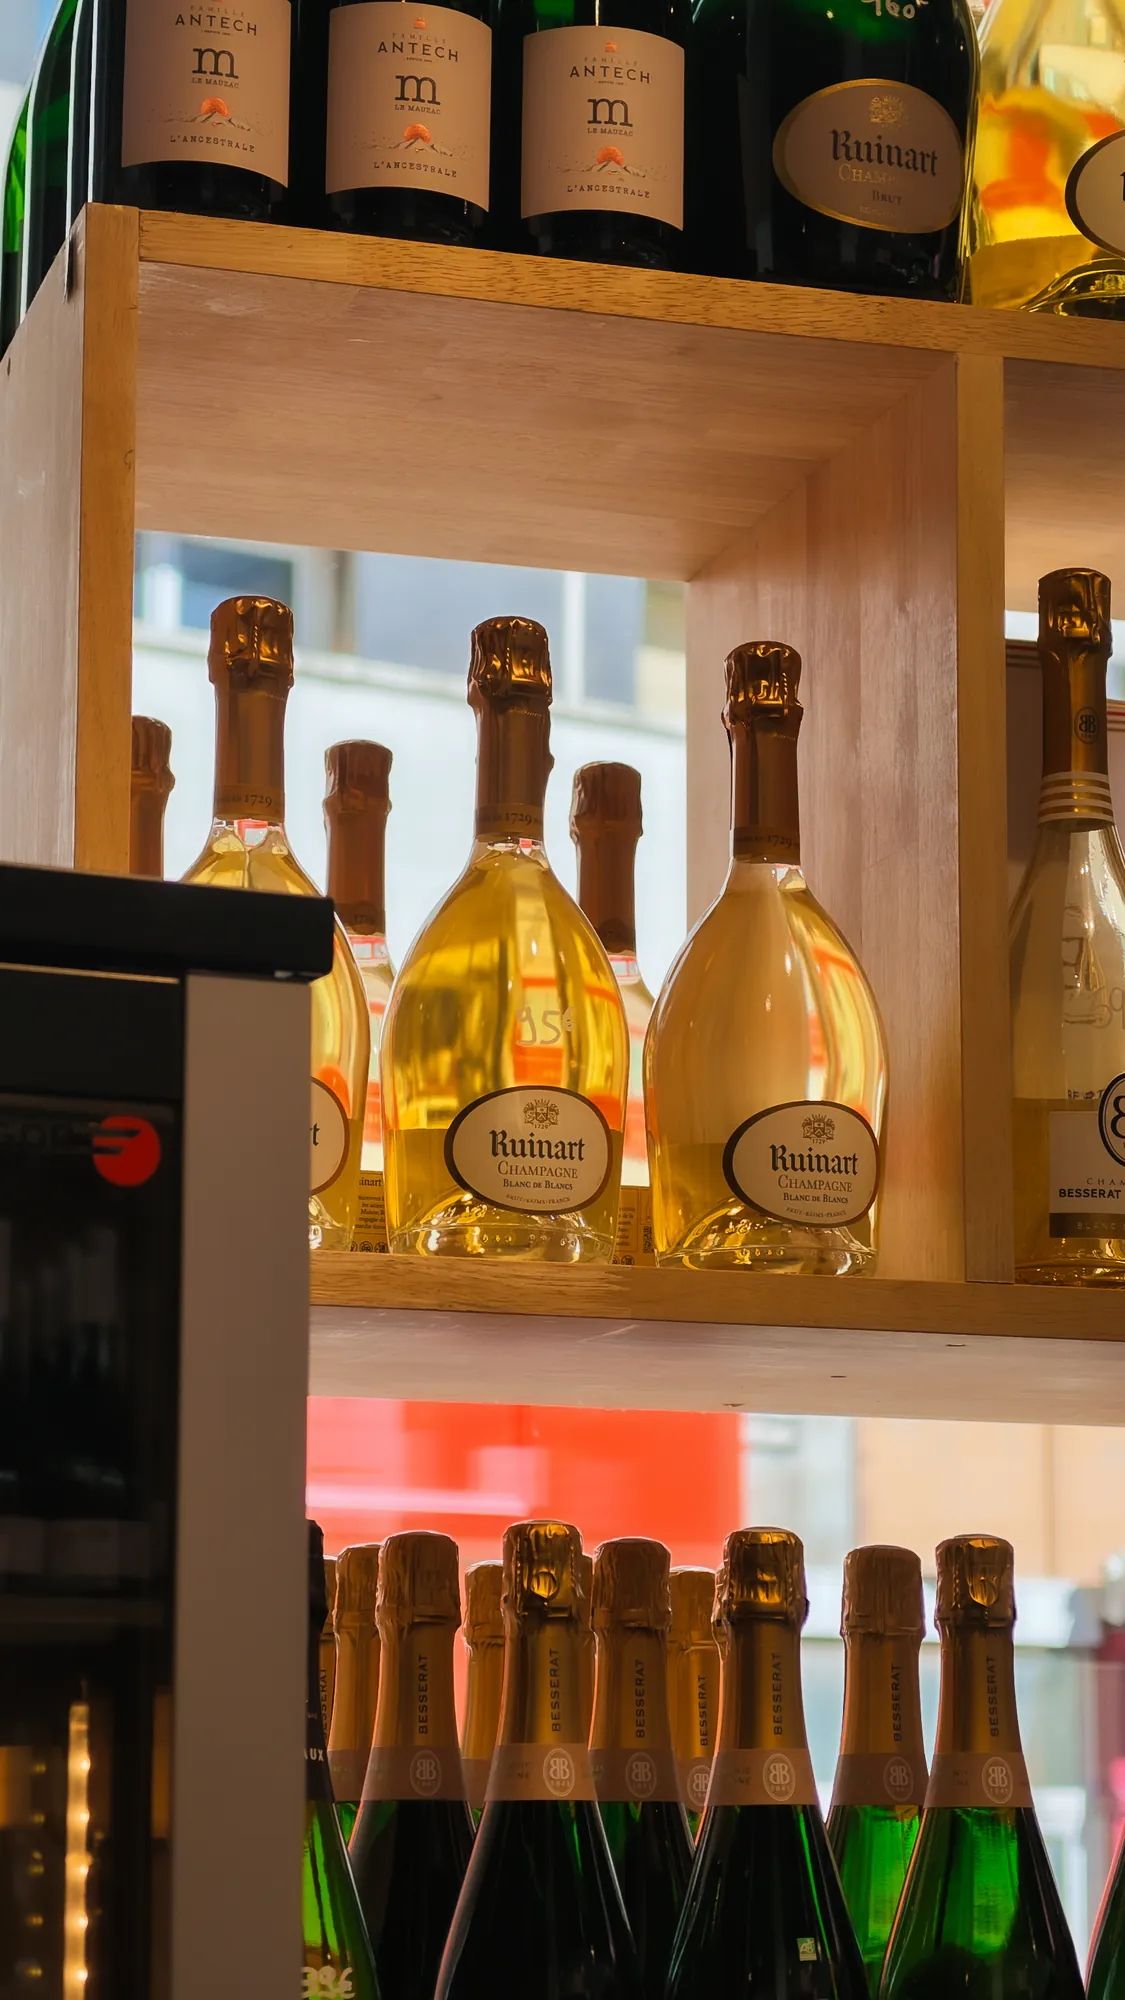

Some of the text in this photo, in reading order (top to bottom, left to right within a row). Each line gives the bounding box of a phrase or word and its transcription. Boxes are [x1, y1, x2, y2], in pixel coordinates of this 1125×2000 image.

[175, 14, 257, 36] ANTECH
[377, 41, 459, 62] ANTECH
[192, 48, 239, 79] m
[205, 78, 239, 89] MAUZAC
[569, 65, 650, 84] ANTECH
[394, 75, 441, 105] m
[408, 104, 441, 115] MAUZAC
[587, 98, 633, 127] m
[600, 128, 633, 137] MAUZAC
[170, 134, 255, 153] L'ANCESTRALE
[830, 129, 938, 176] Ruinart
[374, 161, 457, 178] L'ANCESTRALE
[567, 184, 650, 199] L'ANCESTRALE
[872, 189, 902, 205] BRUT
[244, 793, 273, 808] 1729
[505, 812, 532, 825] 1729
[766, 834, 792, 849] 1729
[488, 1129, 586, 1162] Ruinart
[768, 1144, 858, 1175] Ruinart
[497, 1160, 578, 1179] CHAMPAGNE
[502, 1179, 573, 1190] BLANC DE BLANCS
[778, 1174, 853, 1193] CHAMPAGNE
[783, 1192, 810, 1202] BLANC
[822, 1193, 849, 1204] BLANCS
[1058, 1188, 1122, 1200] BESSERAT
[418, 1654, 428, 1735] BESSERAT
[549, 1648, 561, 1732] BESSERAT
[635, 1659, 645, 1739] BESSERAT
[772, 1652, 783, 1736] BESSERAT
[986, 1655, 999, 1738] BESSERAT
[697, 1675, 709, 1746] BESSERAT
[891, 1664, 902, 1742] BESSERAT
